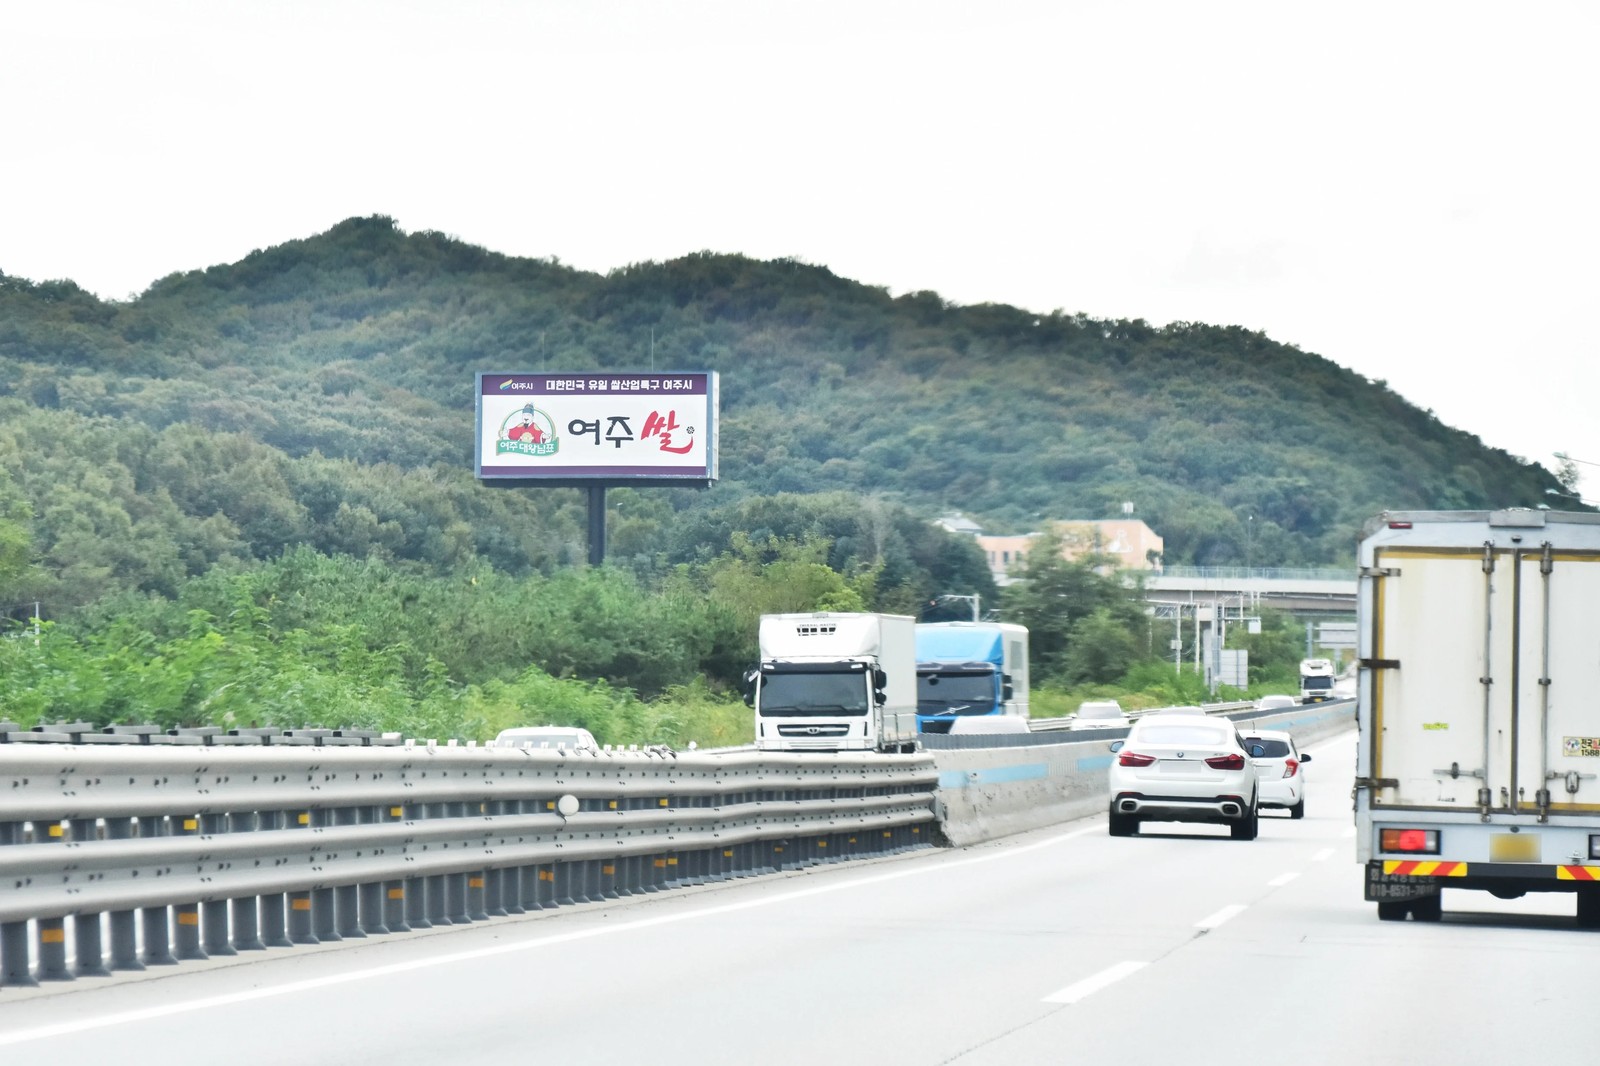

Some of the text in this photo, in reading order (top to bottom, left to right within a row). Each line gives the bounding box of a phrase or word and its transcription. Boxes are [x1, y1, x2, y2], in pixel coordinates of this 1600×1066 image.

[512, 382, 533, 390] 여주시
[546, 380, 693, 390] 대한민국 유일 쌀산업특구 여주시
[567, 409, 694, 455] 여주 쌀
[500, 441, 554, 454] 여주 대왕님표
